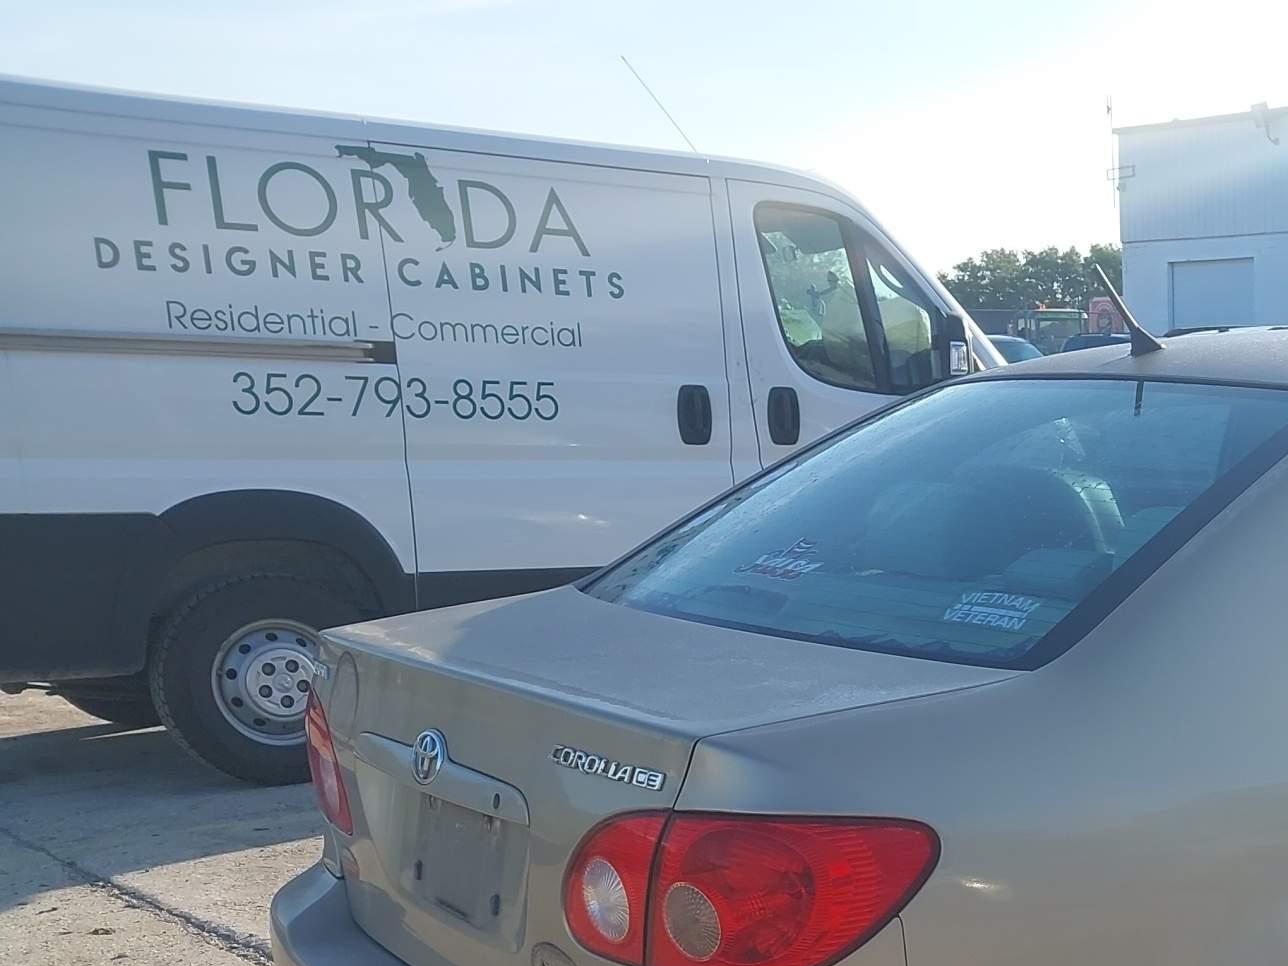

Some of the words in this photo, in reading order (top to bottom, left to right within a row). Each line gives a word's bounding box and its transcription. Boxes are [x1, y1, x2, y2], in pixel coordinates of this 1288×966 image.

[94, 236, 364, 284] DESIGNER
[397, 257, 625, 299] CABINETS
[166, 301, 358, 337] Residential
[391, 312, 583, 347] Commercial
[232, 371, 560, 421] 352-793-8555
[943, 608, 1026, 630] VETERAN
[961, 592, 1040, 618] VIETNAM
[550, 744, 634, 784] COROLLA
[633, 767, 666, 791] CE
